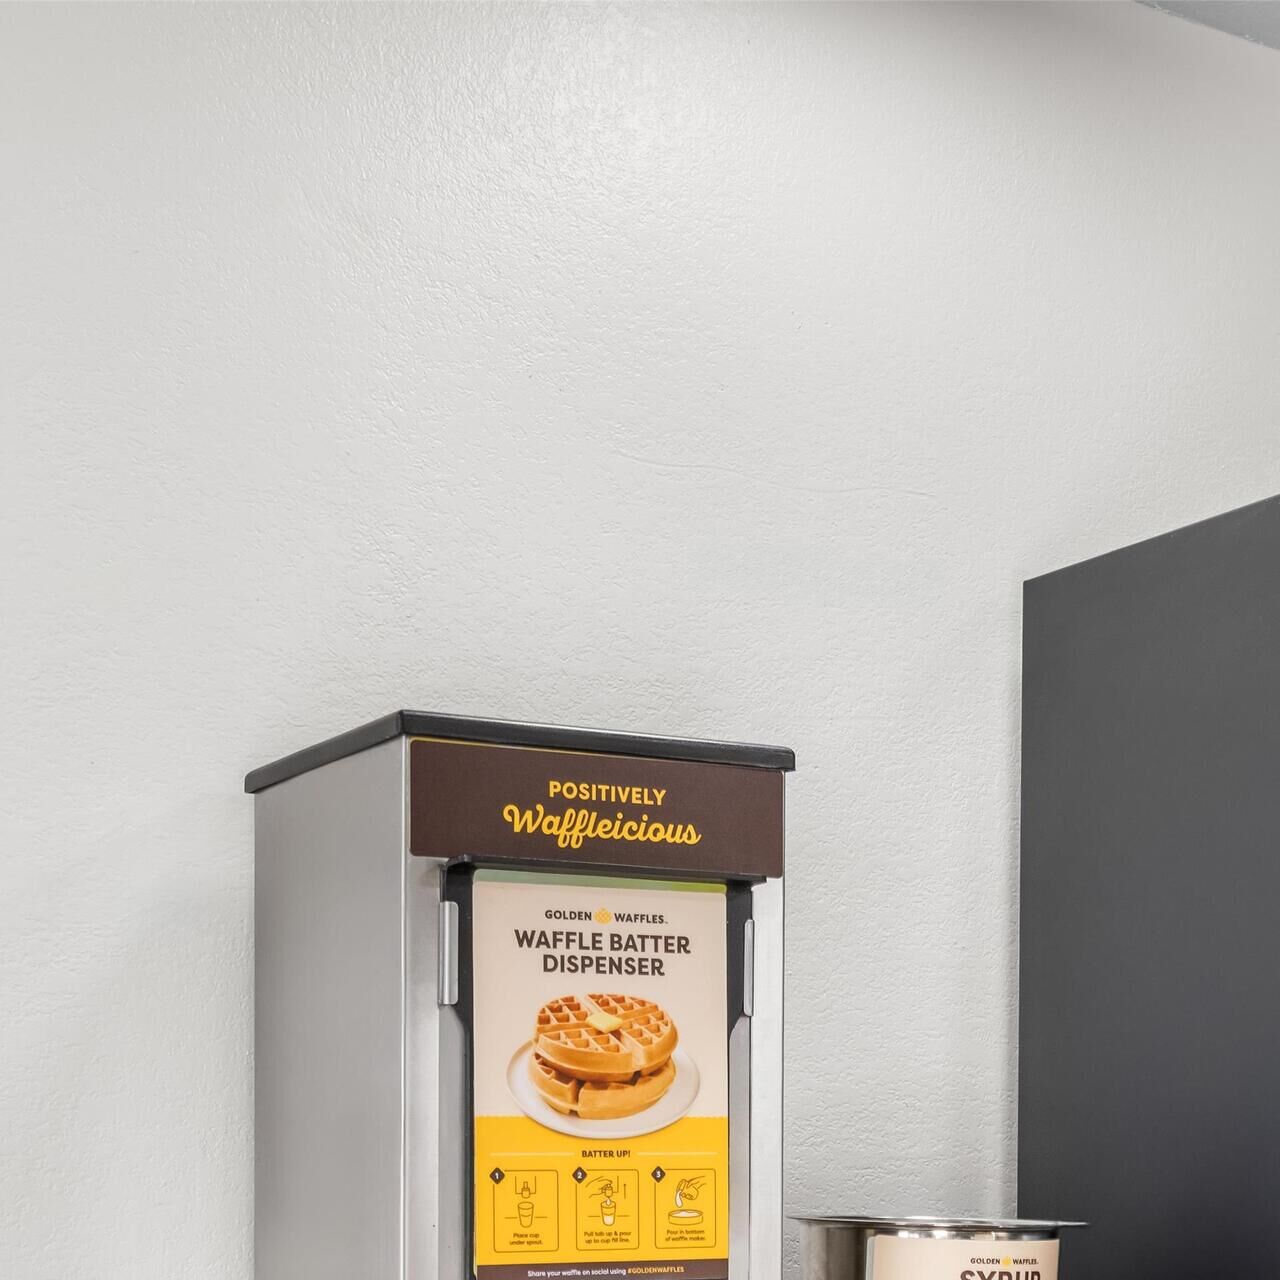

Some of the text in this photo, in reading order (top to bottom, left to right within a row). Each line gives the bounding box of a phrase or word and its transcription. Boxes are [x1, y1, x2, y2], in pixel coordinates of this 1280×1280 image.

[549, 781, 666, 805] POSITIVELY
[503, 804, 702, 849] Waffleicious
[545, 910, 592, 921] GOLDEN
[515, 929, 691, 954] WAFFLE BATTER
[543, 954, 665, 976] DISPENSER
[581, 1150, 631, 1158] BATTER UP!
[494, 1171, 500, 1180] 1
[576, 1171, 583, 1179] 2
[655, 1169, 662, 1178] 3
[547, 1270, 560, 1278] your
[610, 1267, 626, 1275] using
[627, 1266, 685, 1274] #GOLDENWAFFLES
